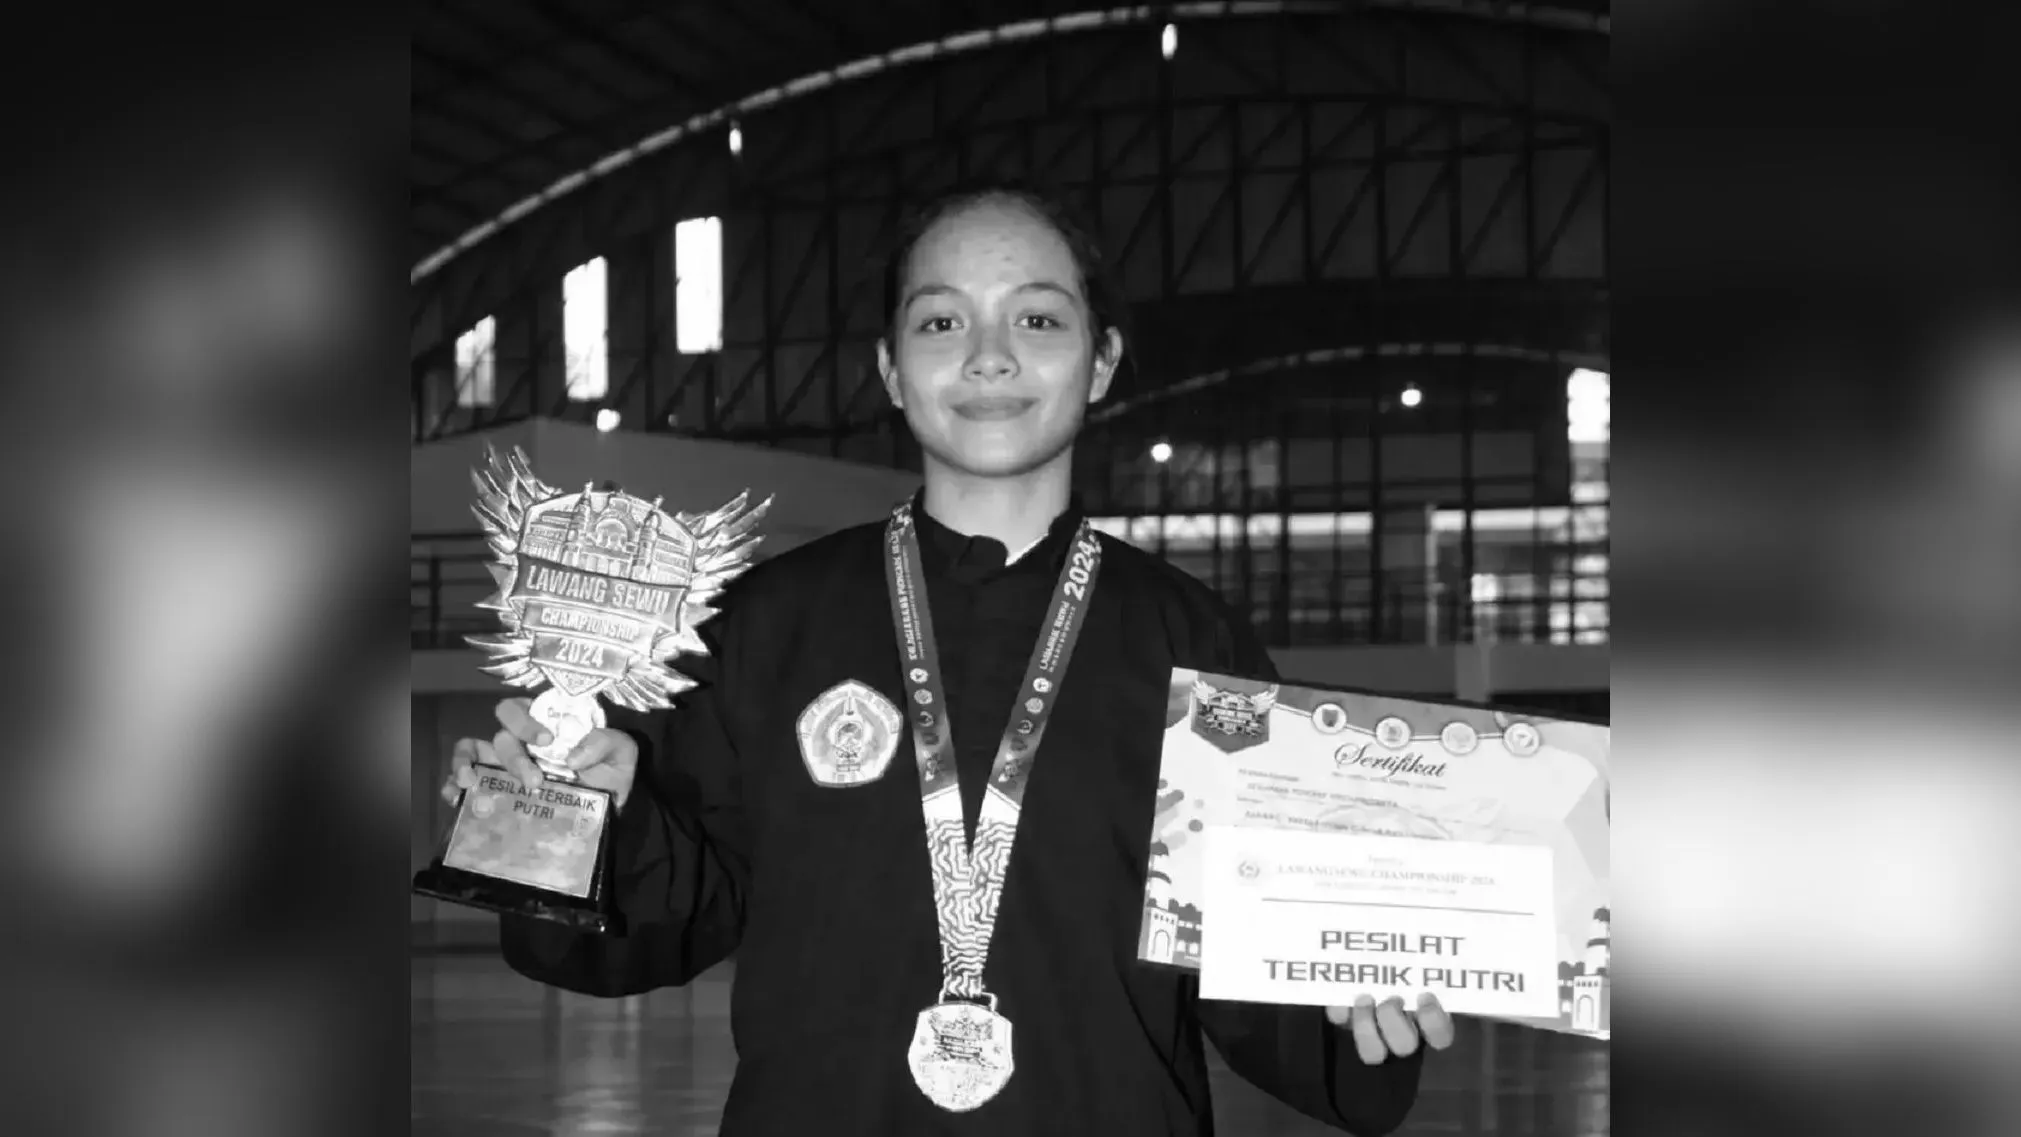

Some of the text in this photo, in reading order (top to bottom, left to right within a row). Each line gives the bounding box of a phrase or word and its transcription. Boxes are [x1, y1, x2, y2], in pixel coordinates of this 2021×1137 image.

[526, 564, 608, 603] LAWANG
[1063, 540, 1096, 601] 2024
[540, 607, 640, 642] CHAMPIONSHIP
[555, 638, 604, 668] 2024
[1333, 742, 1448, 779] Sertifikat
[513, 800, 556, 820] PUTRI
[538, 787, 596, 812] TERBAIK
[1320, 930, 1466, 956] PESILAT
[1262, 958, 1525, 993] TERBAIK PUTRI
